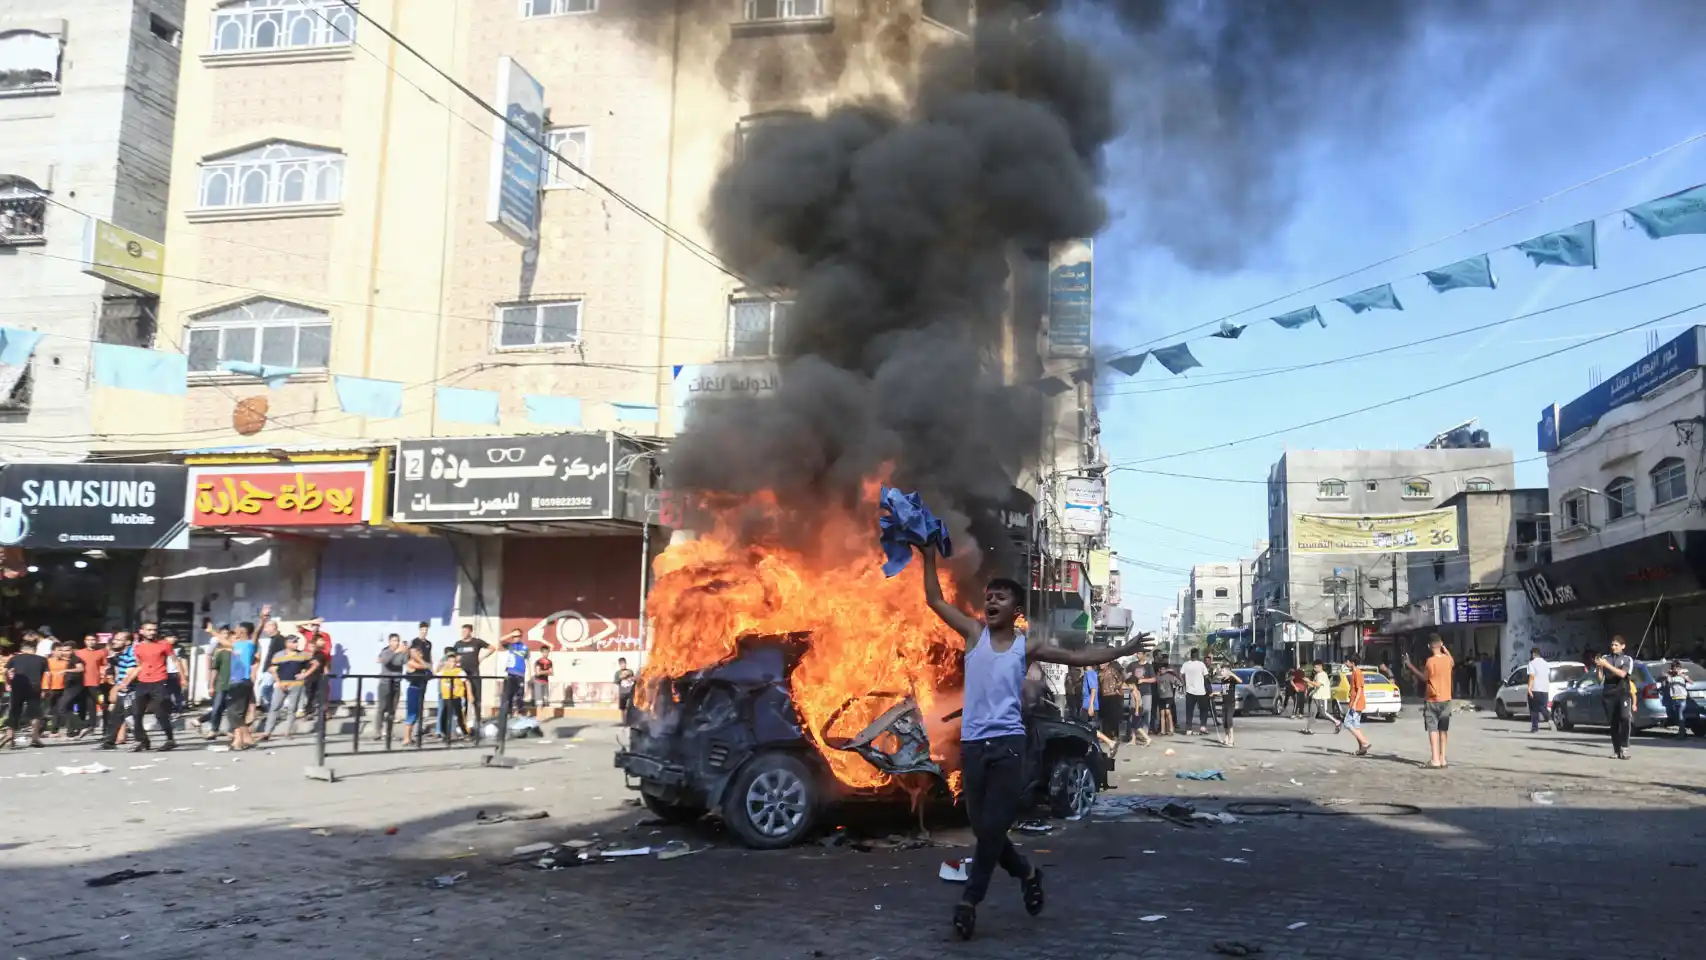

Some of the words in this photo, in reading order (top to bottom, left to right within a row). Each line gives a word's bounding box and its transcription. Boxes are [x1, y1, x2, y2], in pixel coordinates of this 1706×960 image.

[430, 447, 557, 487] عودة
[560, 456, 607, 481] مركز
[21, 480, 156, 507] SAMSUNG
[276, 472, 354, 515] بوظة
[411, 492, 520, 515] للبصريات
[111, 513, 155, 525] Mobile
[1429, 529, 1453, 546] 36
